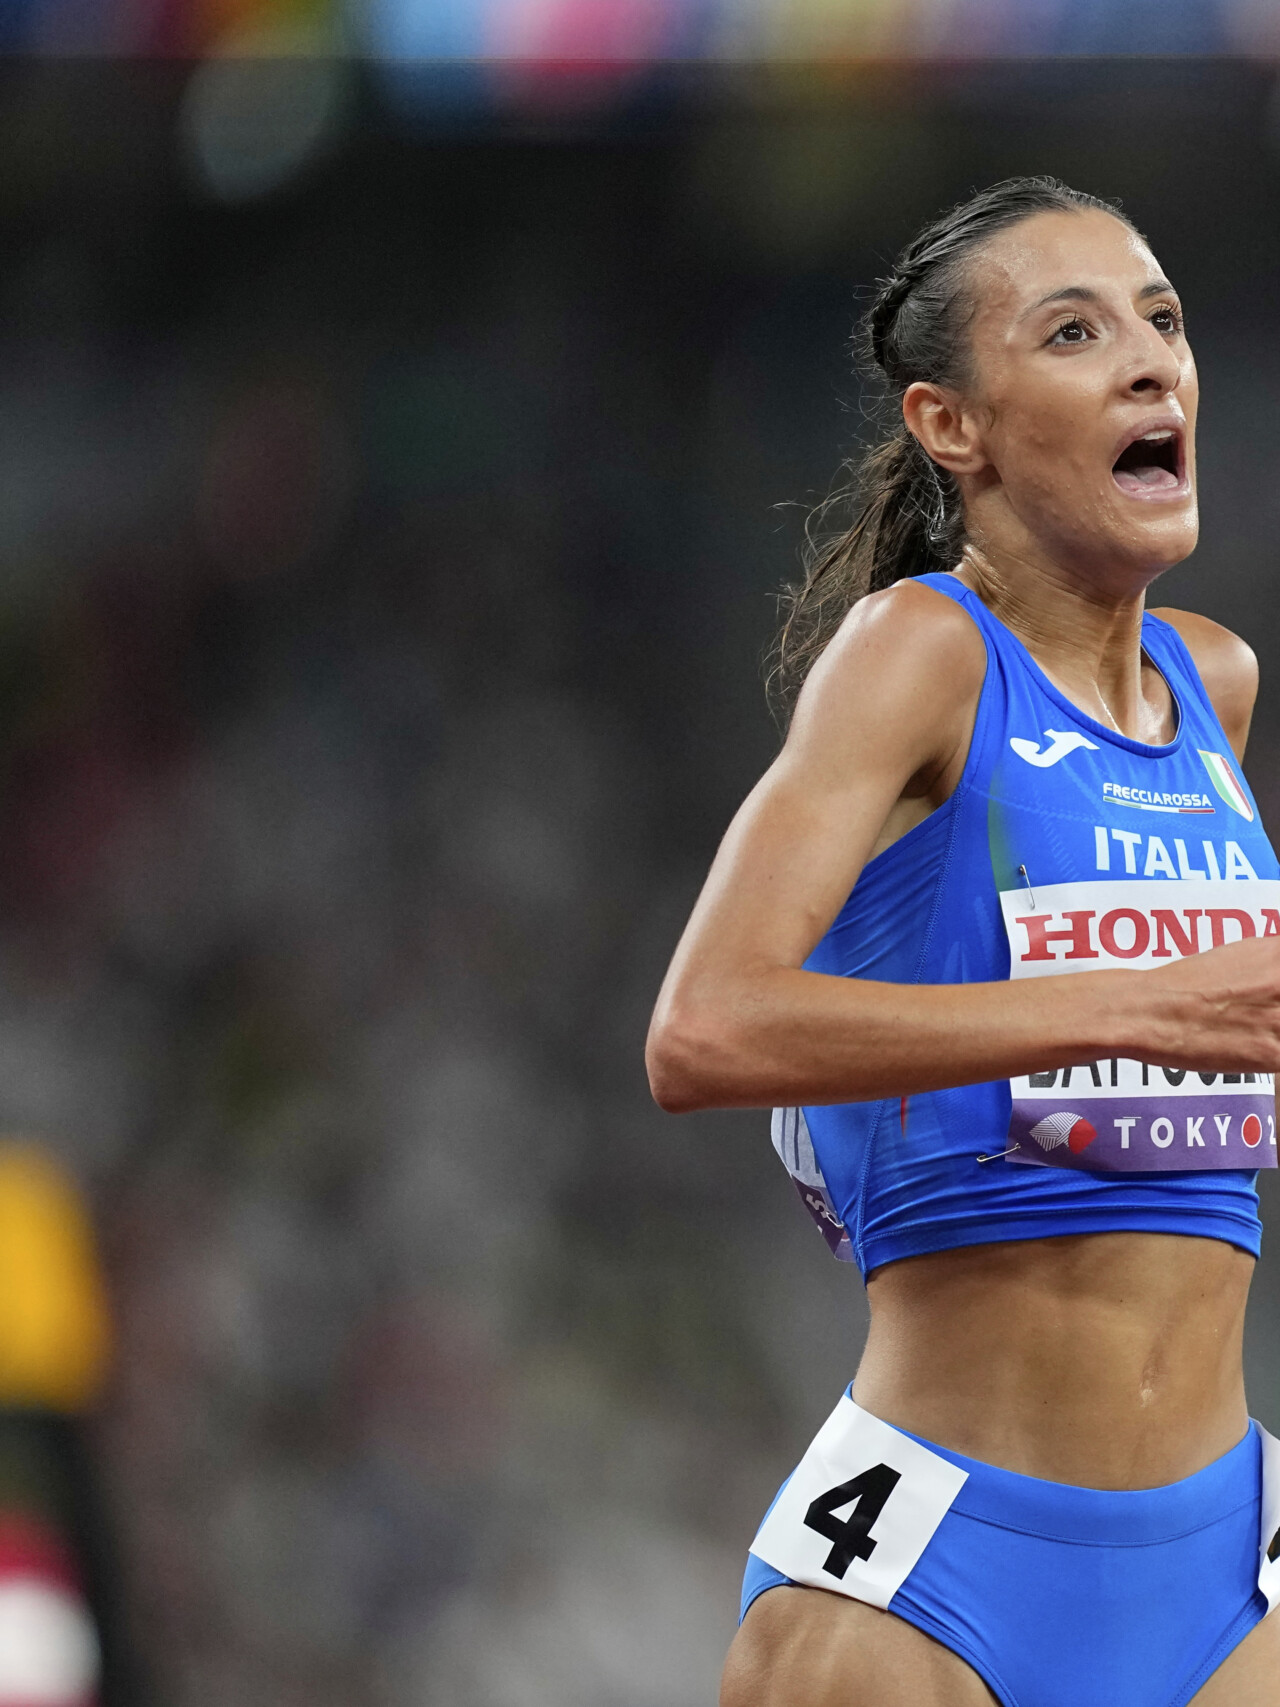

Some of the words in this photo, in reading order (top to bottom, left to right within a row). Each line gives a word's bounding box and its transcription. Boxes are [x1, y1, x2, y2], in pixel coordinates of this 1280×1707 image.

[1103, 782, 1213, 807] FRECCIAROSSA
[1094, 826, 1259, 880] ITALIA
[803, 1462, 902, 1580] 4
